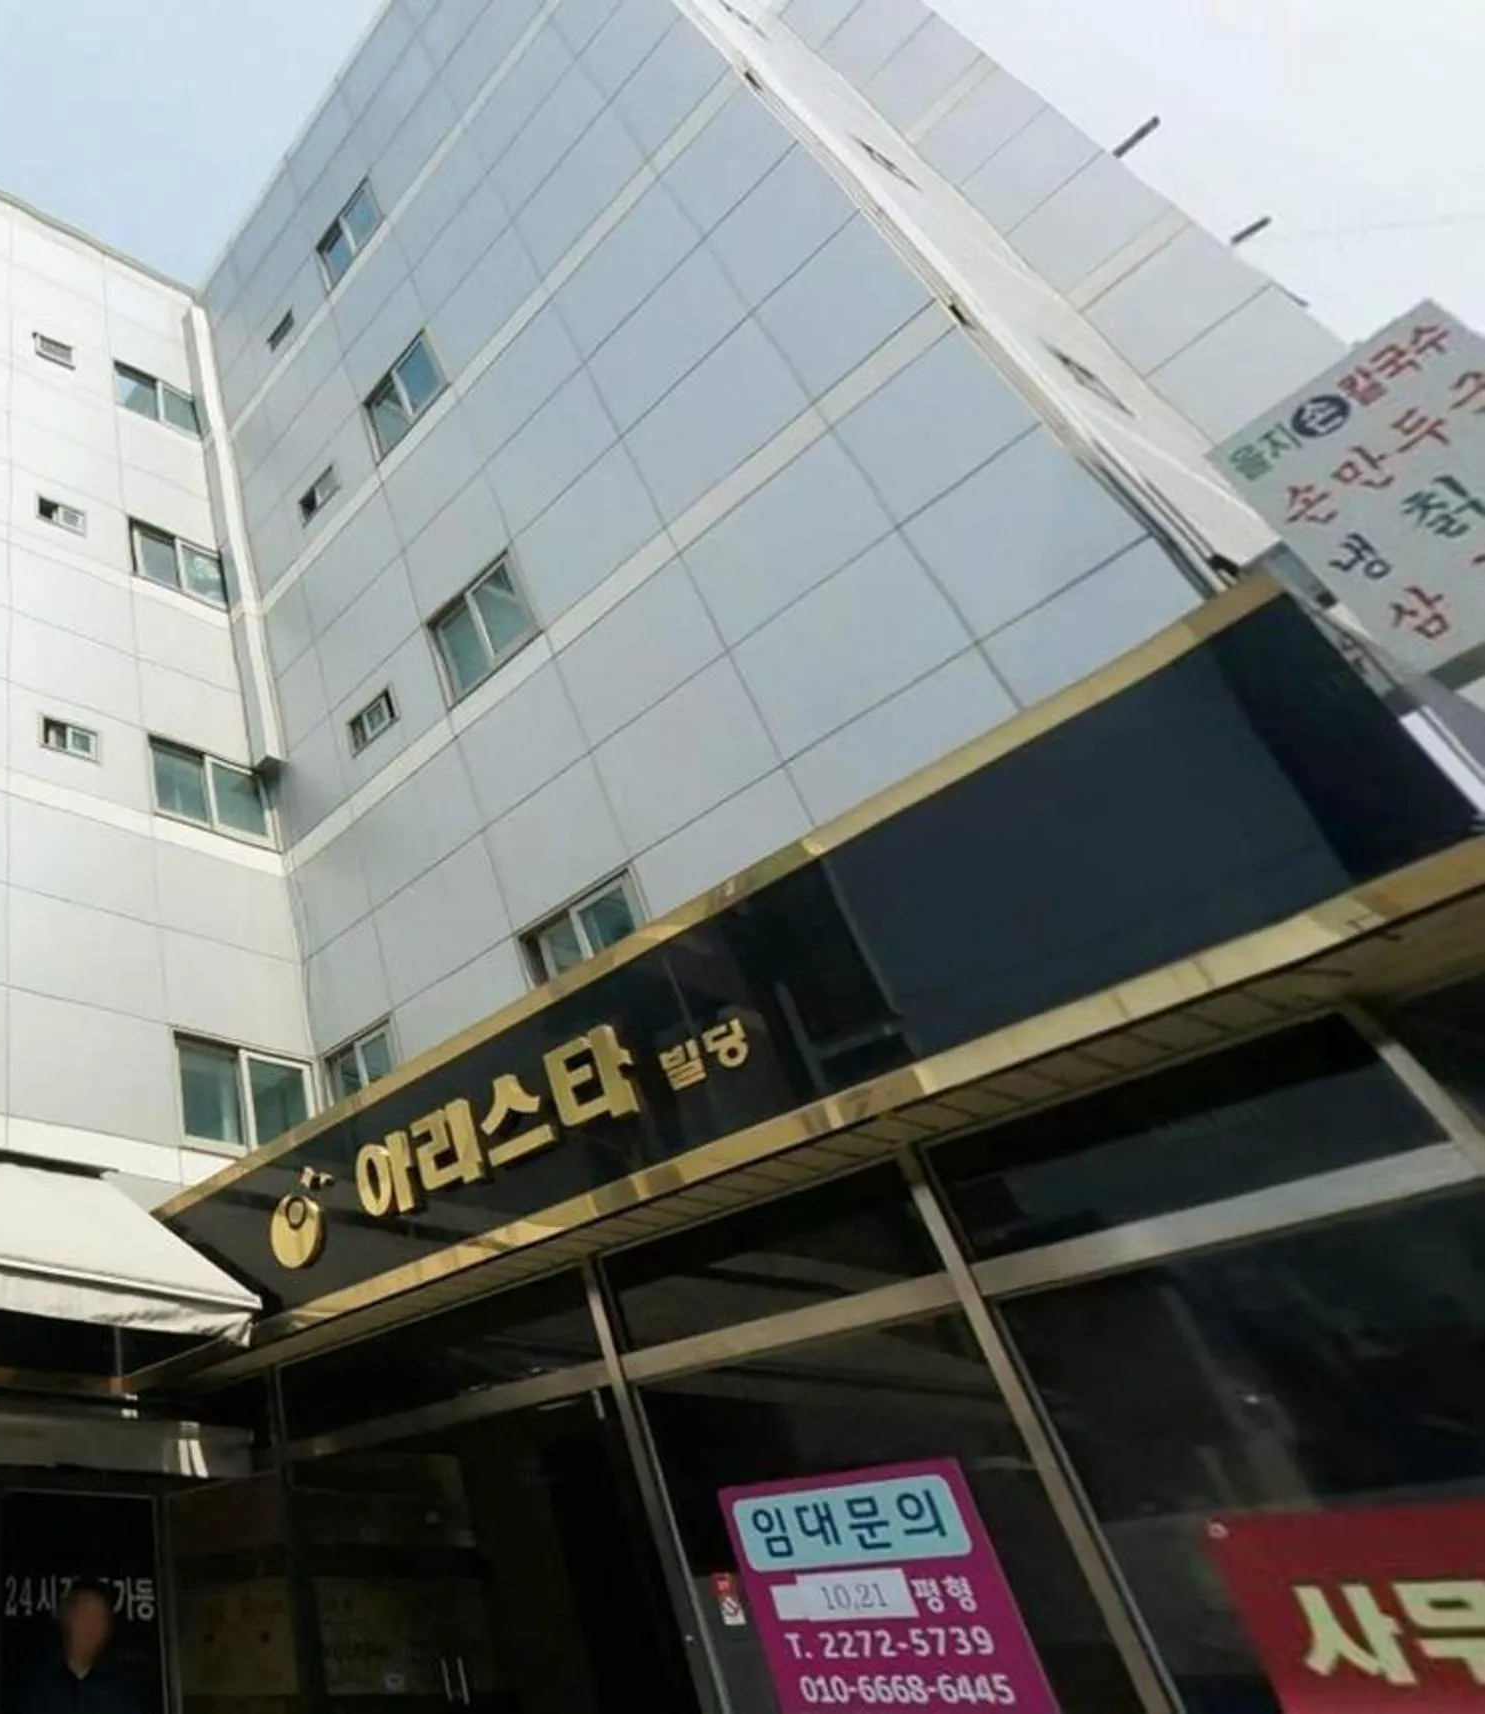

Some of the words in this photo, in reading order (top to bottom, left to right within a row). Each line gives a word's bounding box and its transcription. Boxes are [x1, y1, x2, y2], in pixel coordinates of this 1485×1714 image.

[355, 1023, 640, 1219] 아리스타
[658, 1017, 749, 1092] 빌딩
[751, 1487, 949, 1558] 임대문의
[97, 1574, 157, 1622] 가동
[911, 1574, 978, 1613] 평형
[818, 1625, 995, 1660] 2272-5739
[800, 1673, 1016, 1705] 010-6668-6445
